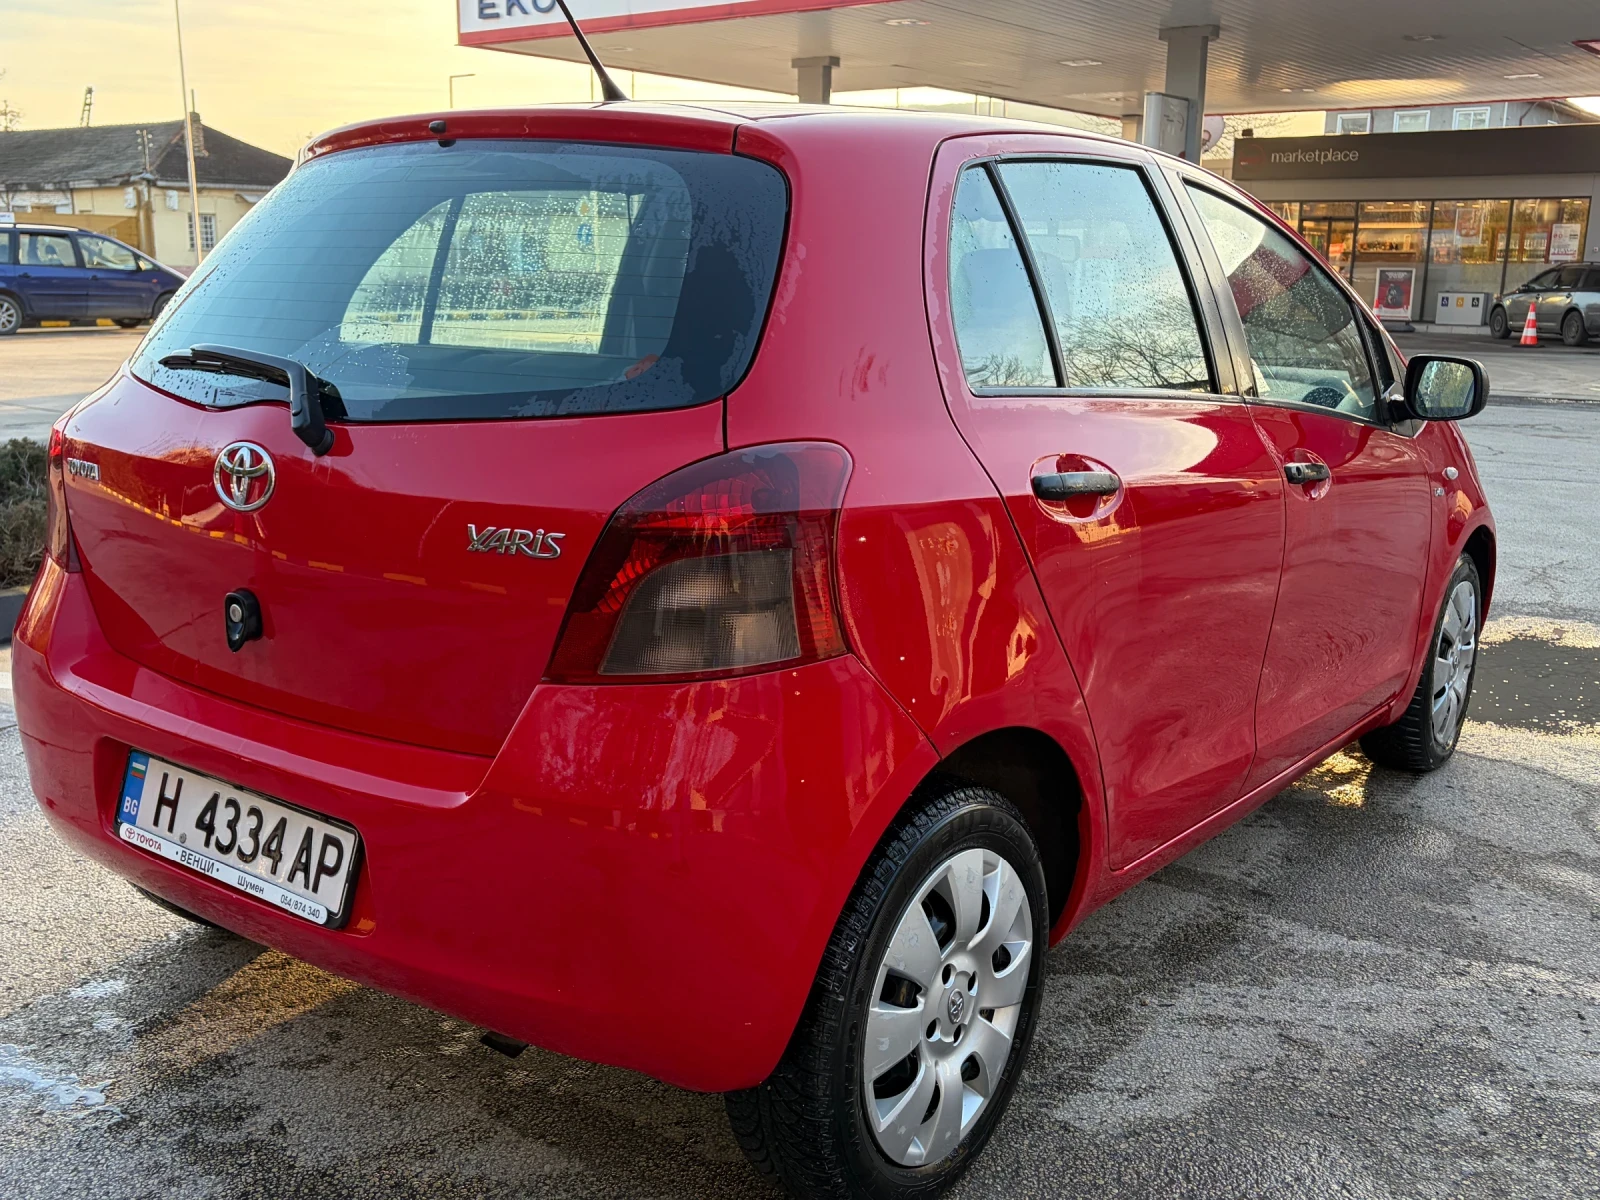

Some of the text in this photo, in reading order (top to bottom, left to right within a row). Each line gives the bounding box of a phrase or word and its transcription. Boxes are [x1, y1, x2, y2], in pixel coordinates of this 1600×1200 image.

[479, 0, 557, 19] EKO
[1271, 148, 1359, 165] marketplace
[123, 796, 139, 816] BG
[136, 832, 162, 852] TOYOTA
[195, 790, 288, 876] 4334
[237, 874, 265, 895] Шумен
[280, 893, 321, 919] 054/874 340
